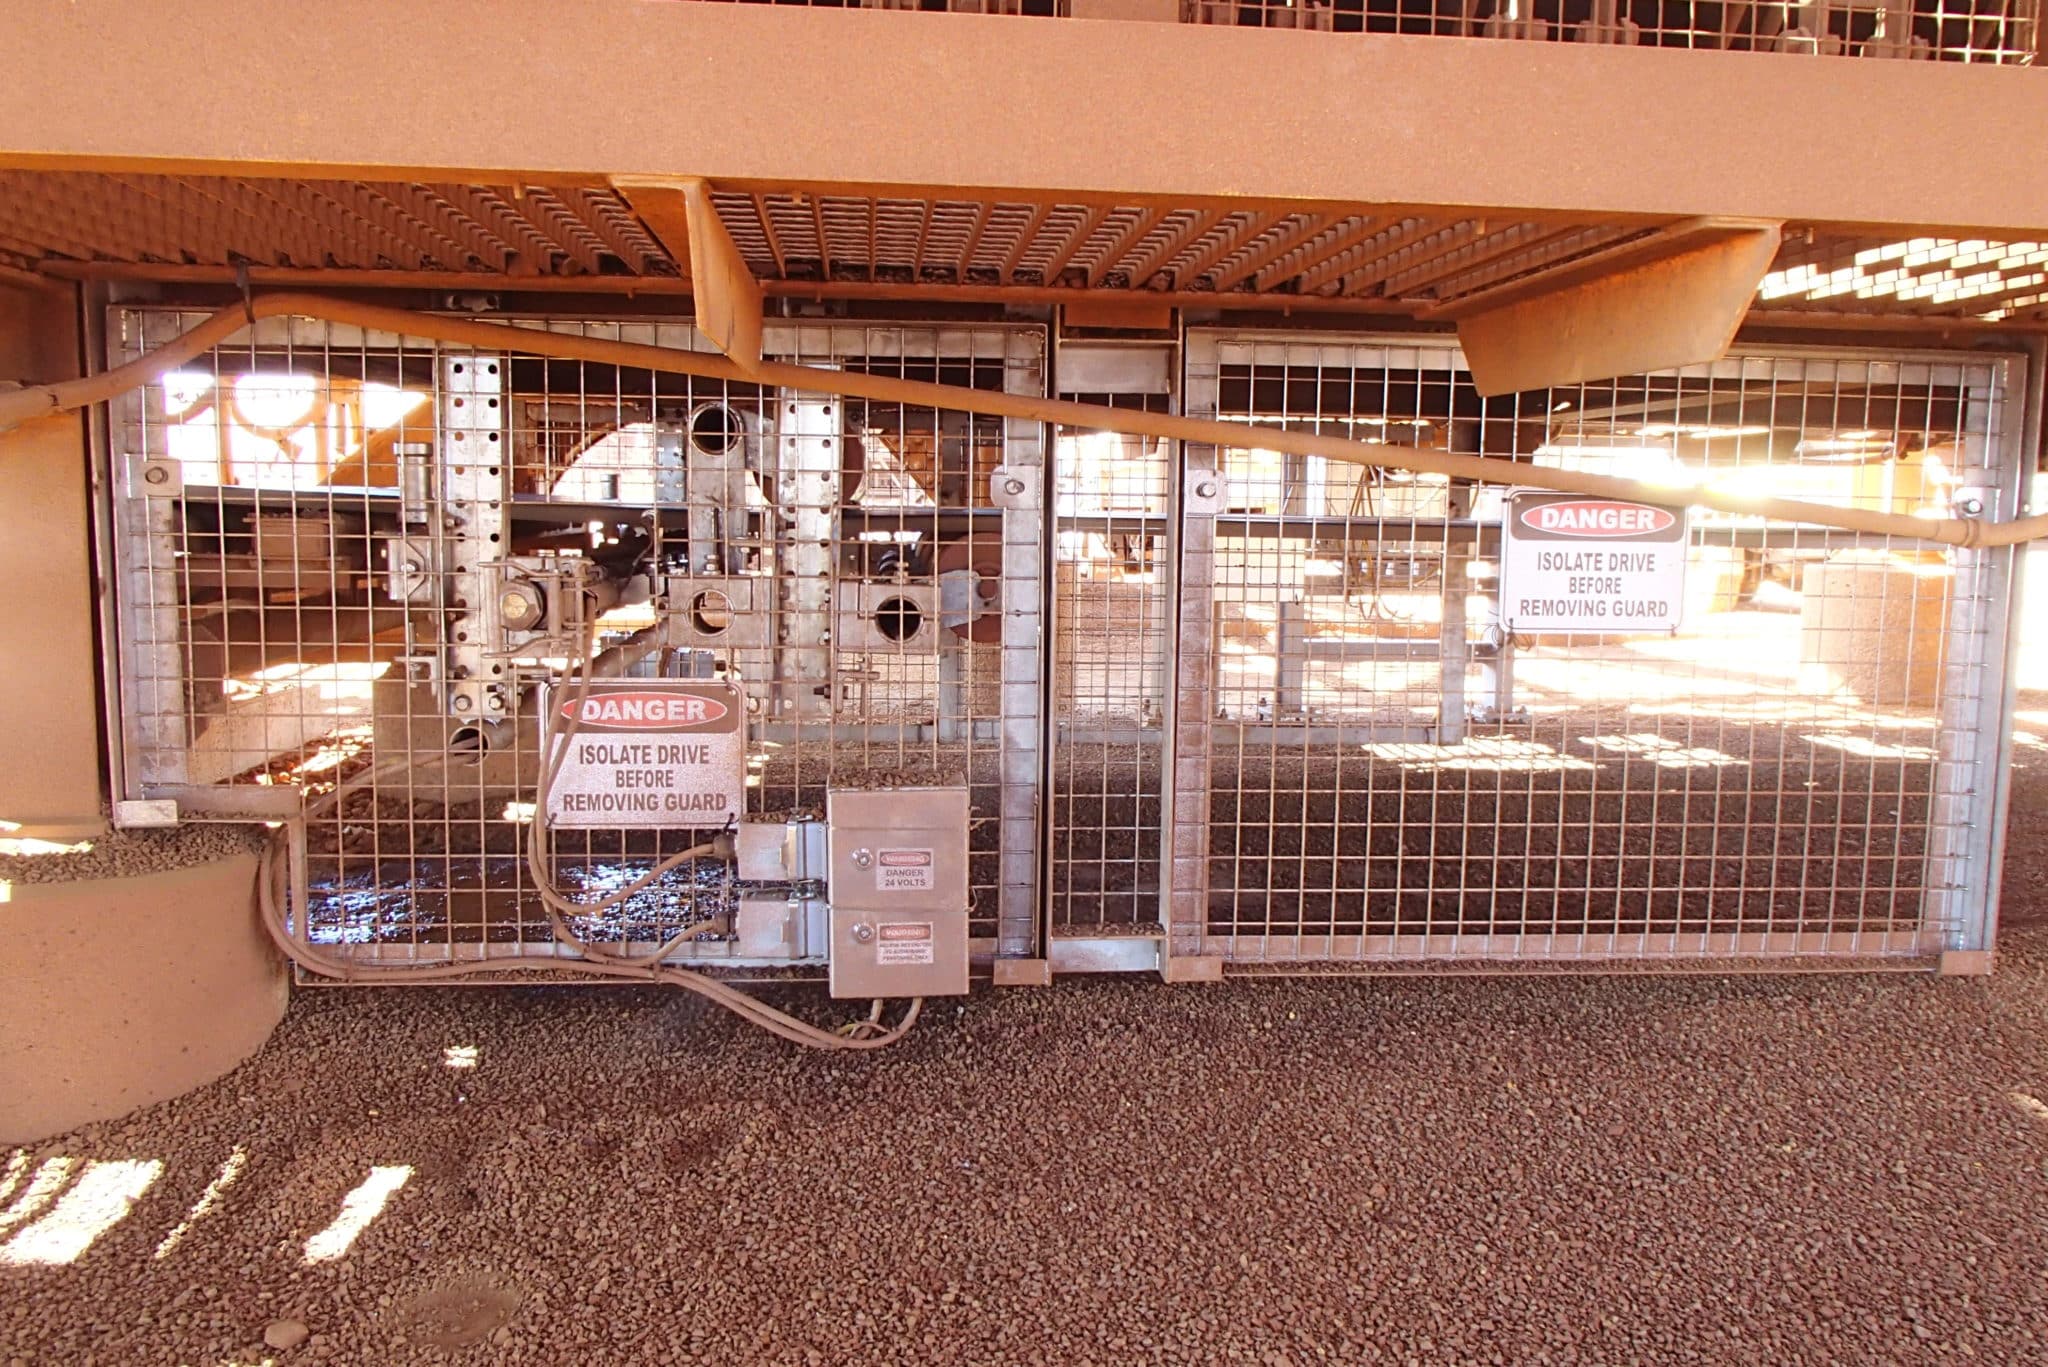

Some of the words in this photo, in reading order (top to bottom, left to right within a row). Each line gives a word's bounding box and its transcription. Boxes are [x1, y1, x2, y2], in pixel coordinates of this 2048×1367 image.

[1541, 508, 1656, 530] DANGER
[1537, 552, 1603, 572] ISOLATE
[1608, 553, 1656, 572] DRIVE
[1569, 577, 1622, 594] BEFORE
[1520, 599, 1606, 617] REMOVING
[1612, 600, 1668, 617] GUARD
[581, 699, 708, 721] DANGER
[579, 744, 652, 765] ISOLATE
[657, 744, 710, 765] DRIVE
[615, 770, 674, 788] BEFORE
[563, 793, 659, 811] REMOVING
[664, 793, 727, 811] GUARD
[886, 869, 924, 877] DANGER
[885, 879, 896, 887] 24
[897, 879, 926, 887] VOLTS
